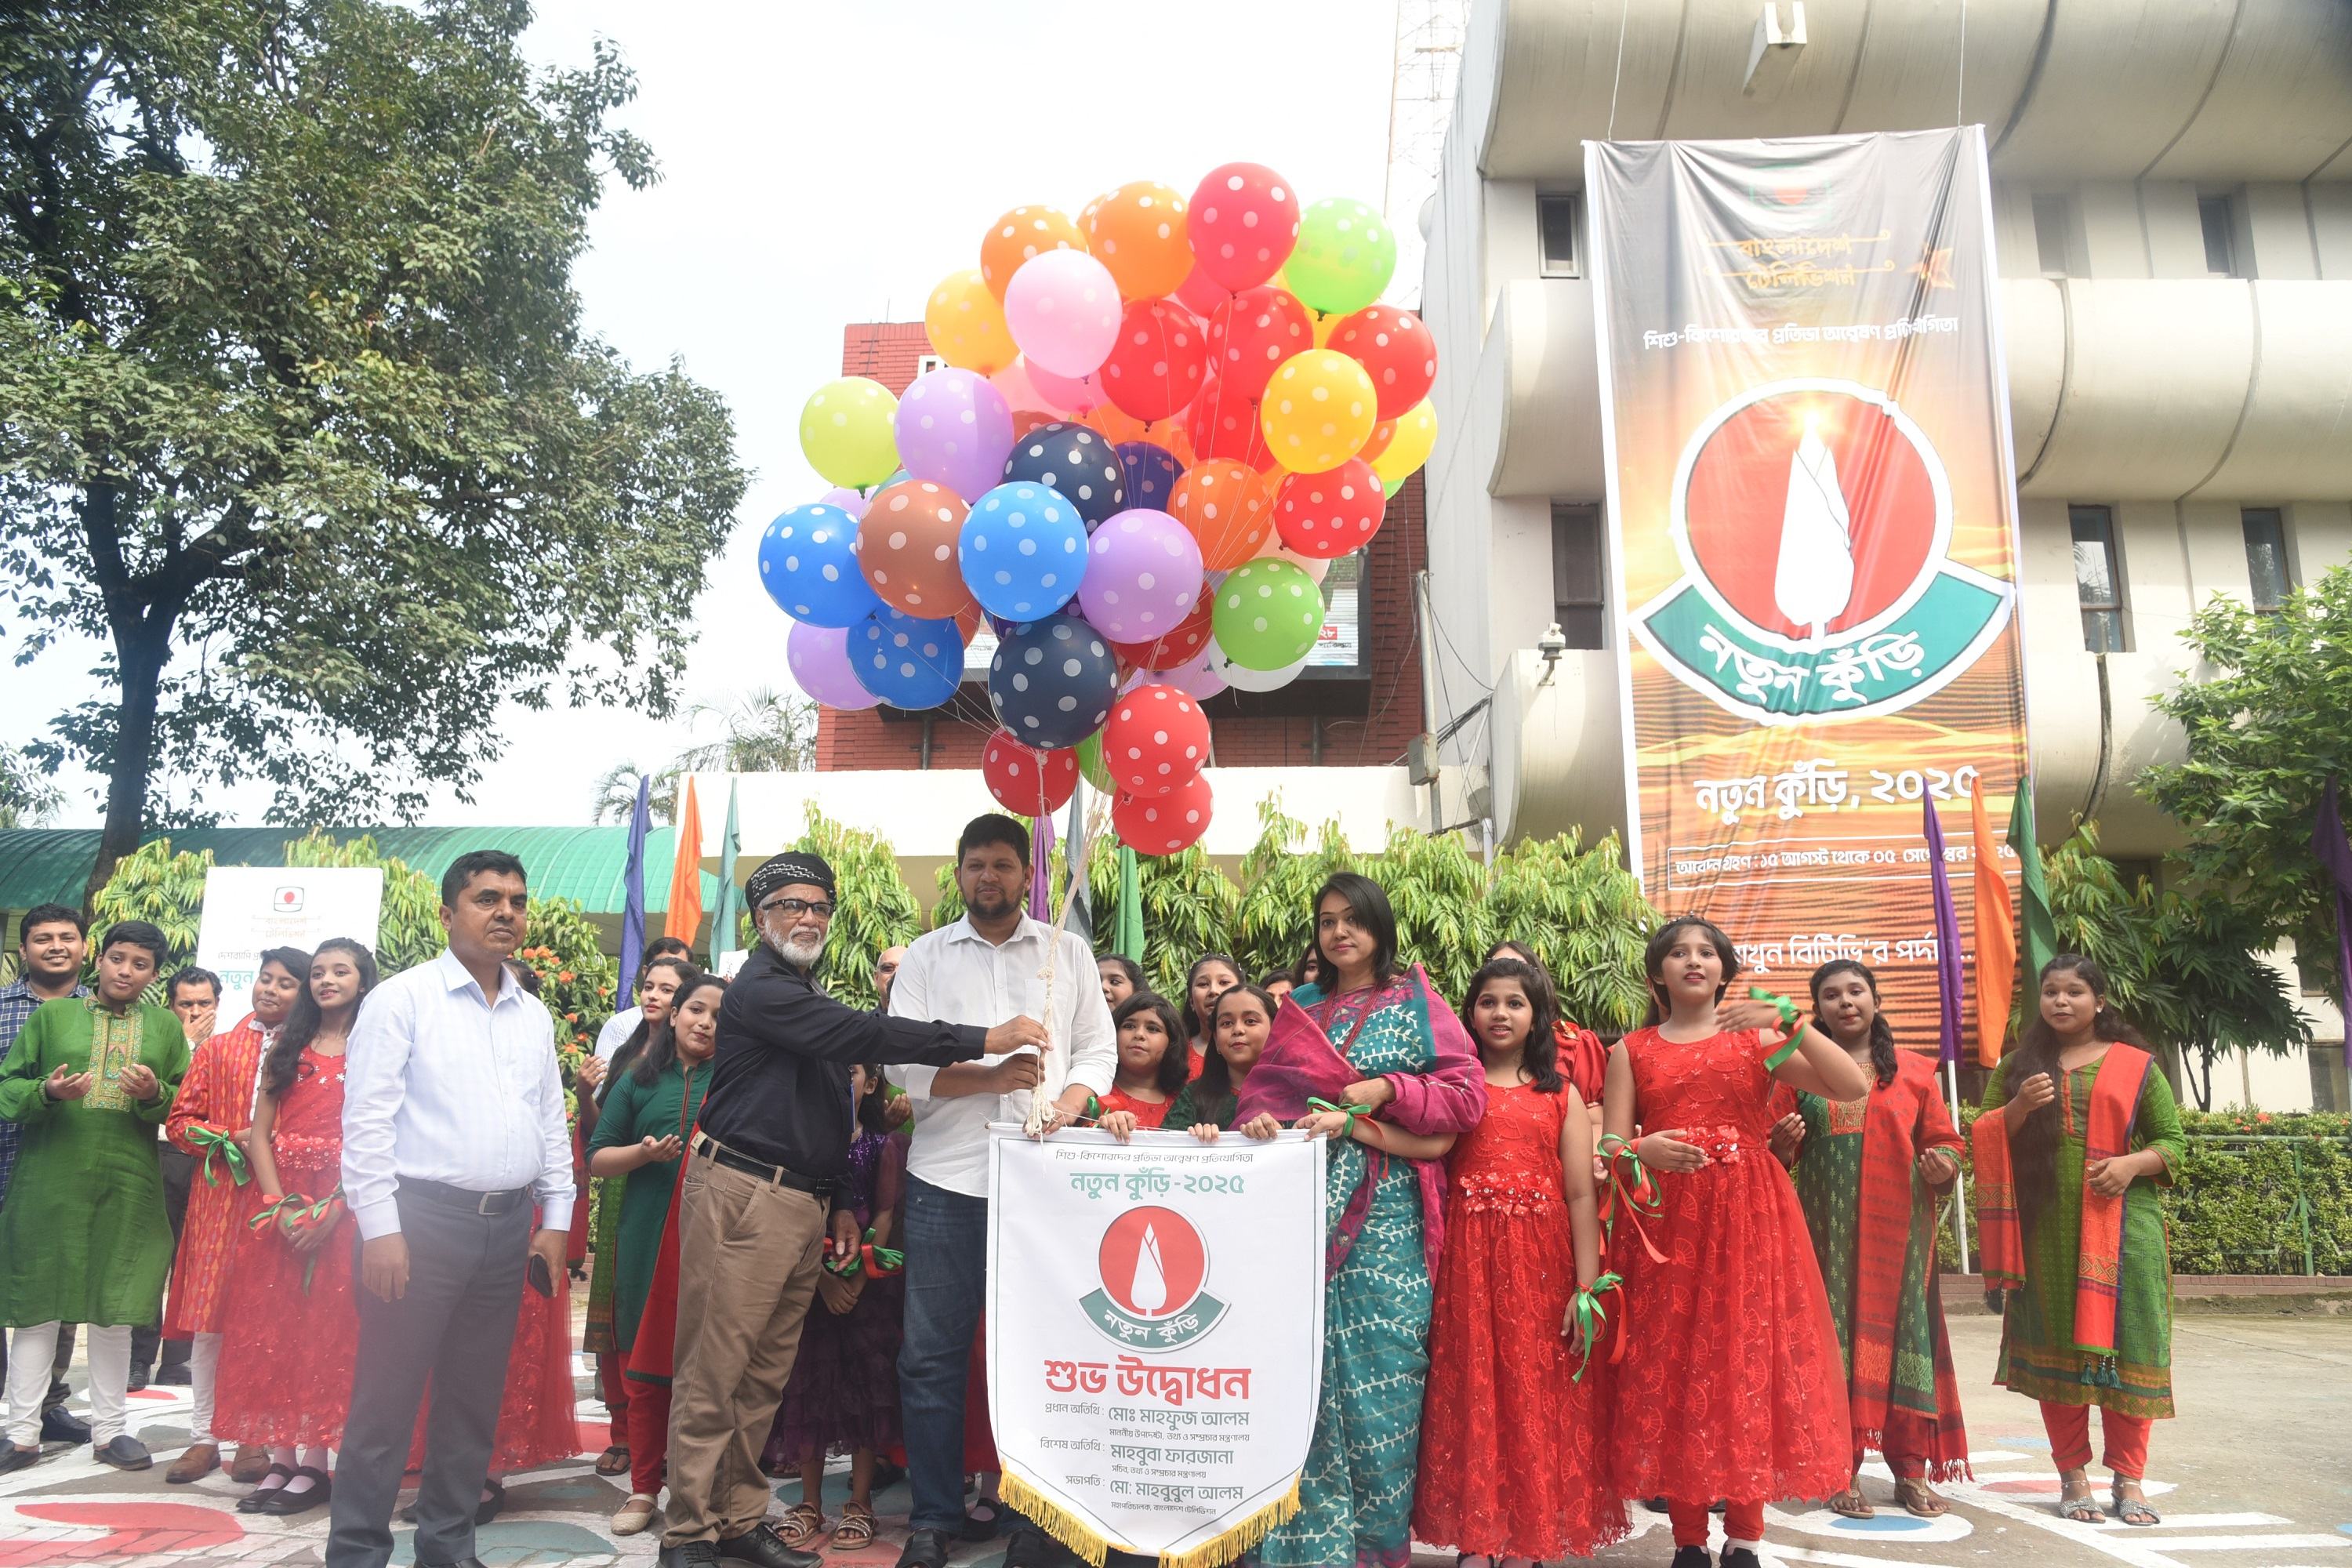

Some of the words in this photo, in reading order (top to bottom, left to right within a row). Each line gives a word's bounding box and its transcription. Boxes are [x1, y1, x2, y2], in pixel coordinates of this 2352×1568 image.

[1772, 322, 1820, 344] প্রতিভা
[1699, 623, 1809, 703] নতুন
[1816, 631, 1925, 705] কুঁড়ি
[1693, 775, 1766, 825] নতুন
[1781, 848, 1828, 866] আগস্ট
[1831, 850, 1870, 865] থেকে
[1874, 850, 1896, 864] ০৫
[219, 971, 255, 990] নতুন
[1133, 1152, 1161, 1162] প্রতিভা
[1164, 1155, 1199, 1163] অন্বেষণ
[1201, 1152, 1253, 1163] প্রতিযোগিতা
[1070, 1173, 1120, 1199] নতুন
[1104, 1309, 1151, 1342] নতুন
[1157, 1313, 1200, 1345] কুঁড়ি
[1044, 1359, 1109, 1393] শুভ
[1115, 1354, 1252, 1406] উদ্বোধন
[1045, 1403, 1068, 1414] প্রধান
[1109, 1407, 1135, 1421] মোঃ
[1140, 1409, 1198, 1431] মাহফুজ
[1201, 1411, 1250, 1426] আলম
[1109, 1428, 1133, 1437] মাননীয়
[1134, 1429, 1164, 1440] উপদেষ্টা,
[1219, 1434, 1250, 1443] মন্ত্রণালয়
[1040, 1439, 1068, 1450] বিশেষ
[1111, 1444, 1161, 1466] মাহবুবা
[1165, 1449, 1234, 1465] ফারজানা
[1112, 1465, 1129, 1474] সচিব,
[1178, 1470, 1206, 1479] মন্ত্রণালয়
[1066, 1474, 1101, 1486] সভাপতি
[1136, 1483, 1194, 1502] মাহবুবুল
[1197, 1486, 1243, 1500] আলম
[1153, 1504, 1183, 1512] বাংলাদেশ
[1184, 1504, 1216, 1515] টেলিভিশন
